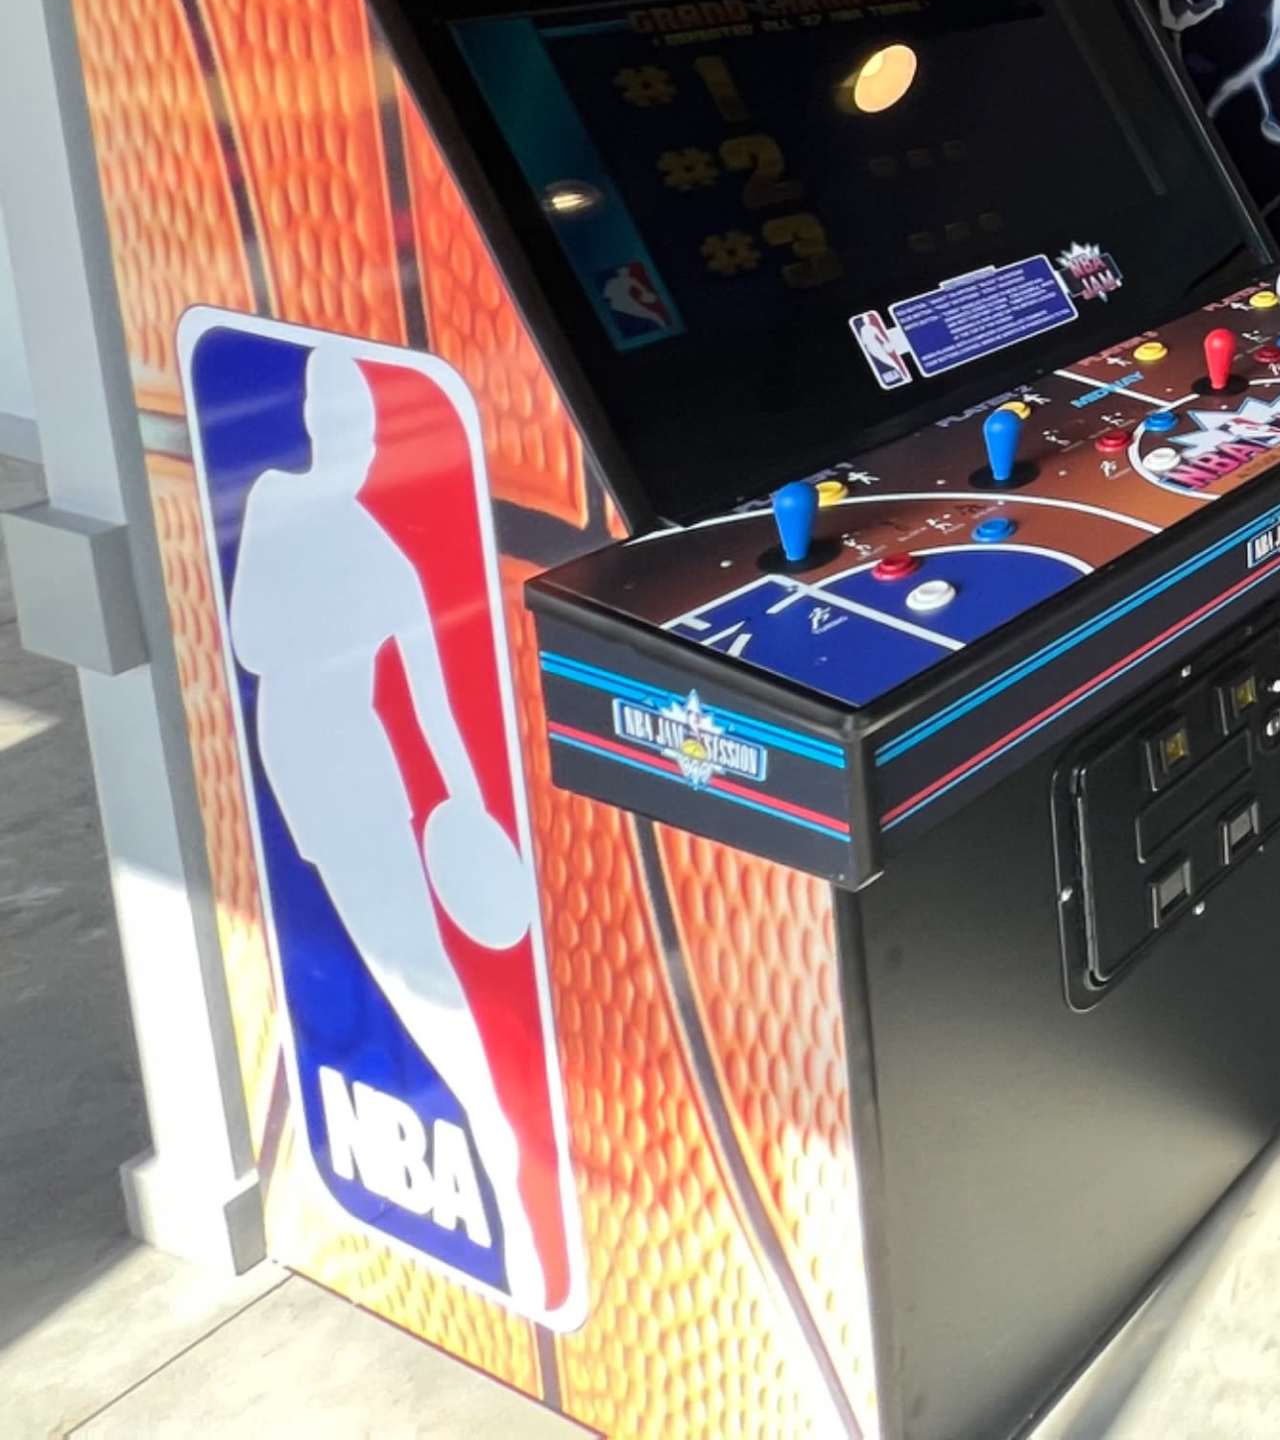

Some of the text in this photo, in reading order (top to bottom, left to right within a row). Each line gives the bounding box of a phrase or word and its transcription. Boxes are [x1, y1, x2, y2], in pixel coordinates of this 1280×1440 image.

[1080, 269, 1121, 301] JAM
[1165, 440, 1268, 490] NBA
[623, 706, 652, 740] NBA
[702, 733, 758, 777] SESSION
[319, 1066, 493, 1248] NBA
